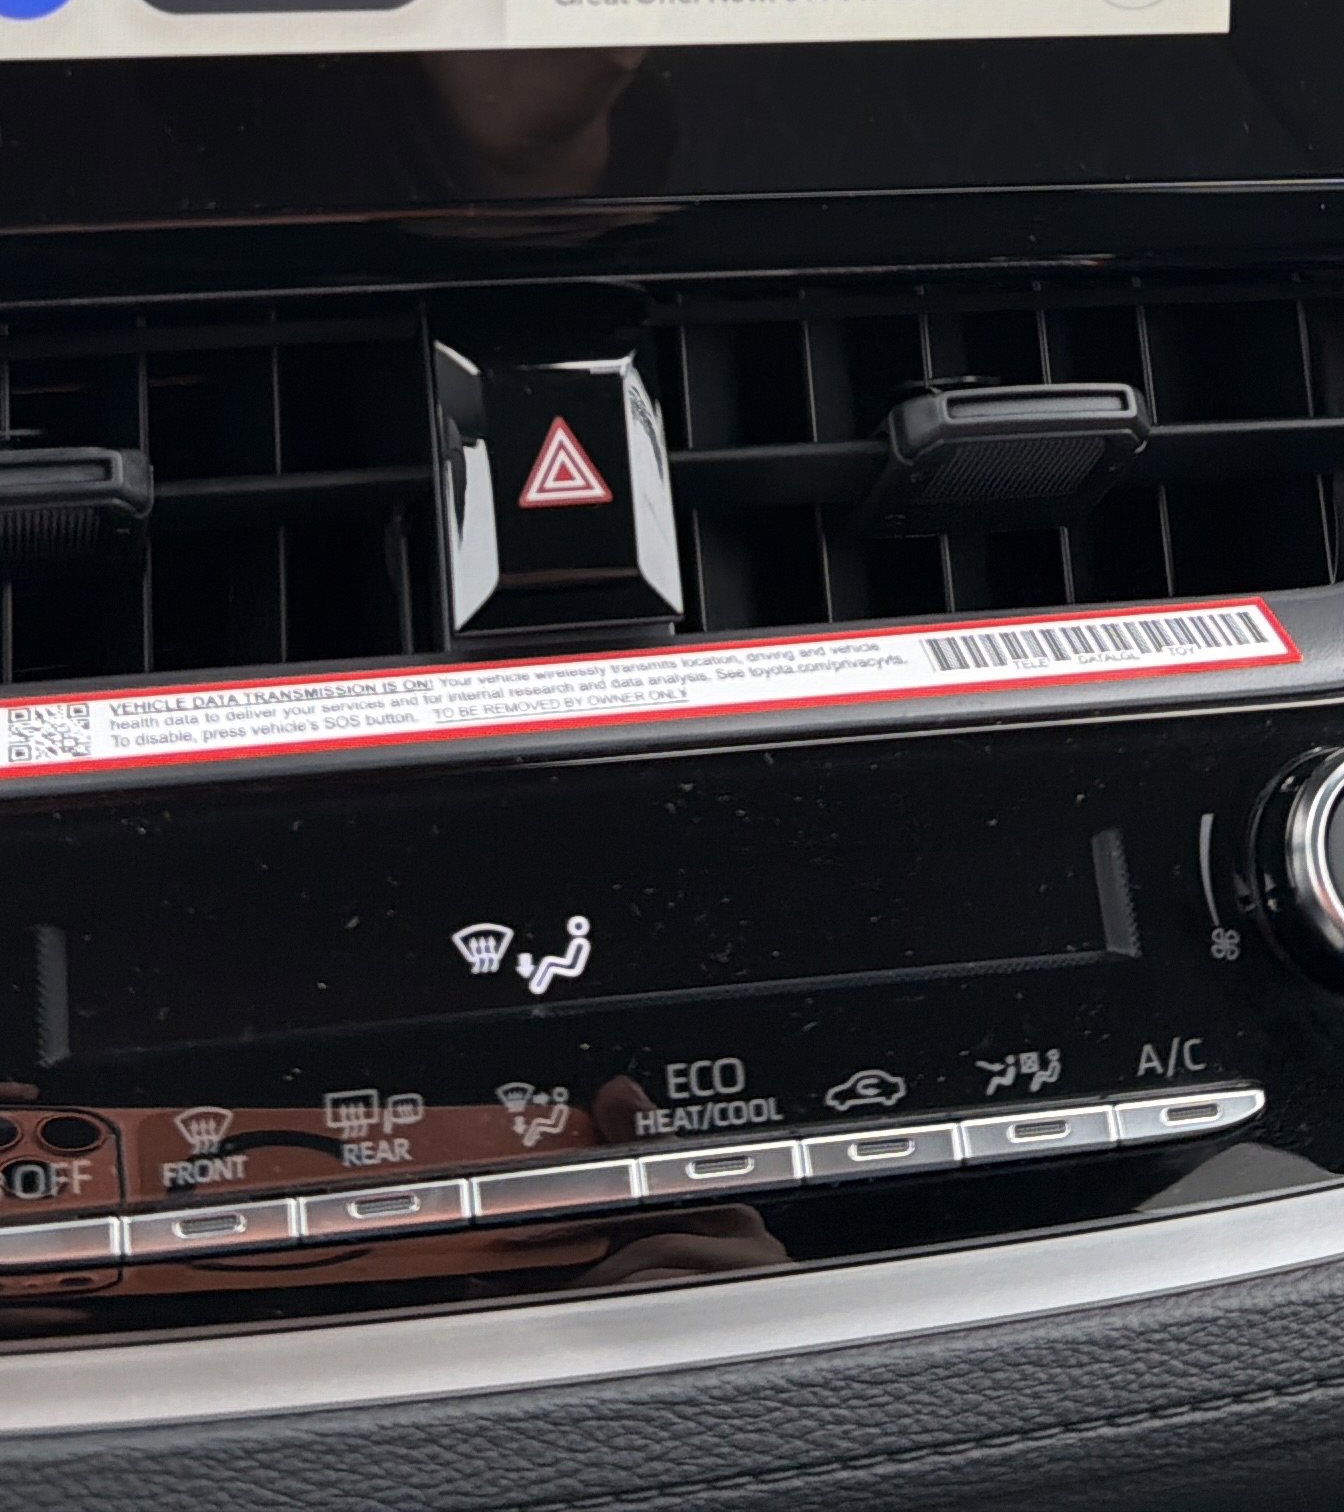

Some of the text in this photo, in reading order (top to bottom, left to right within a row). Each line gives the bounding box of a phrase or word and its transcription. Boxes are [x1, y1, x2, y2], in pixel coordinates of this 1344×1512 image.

[109, 697, 187, 716] VEHICLE
[192, 693, 239, 710] DATA
[243, 682, 377, 705] TRANSMISSION
[382, 680, 398, 693] IS
[439, 677, 473, 688] Your
[478, 673, 530, 685] vehicle
[611, 659, 678, 674] transmits
[799, 645, 826, 658] and
[830, 641, 880, 655] vehicle
[110, 717, 160, 731] health
[164, 713, 199, 727] data
[205, 711, 220, 724] to
[225, 705, 277, 722] deliver
[283, 704, 316, 719] your
[321, 699, 386, 714] services
[390, 694, 419, 708] and
[423, 692, 443, 705] for
[448, 687, 504, 703] internal
[509, 682, 576, 698] research
[579, 679, 607, 692] and
[610, 677, 644, 690] data
[715, 667, 746, 680] See
[111, 734, 131, 749] To
[203, 725, 247, 743] press
[251, 717, 320, 736] vehicle's
[324, 714, 361, 731] SOS
[432, 707, 455, 721] TO
[459, 705, 480, 719] BE
[483, 697, 561, 716] REMOVED
[564, 694, 583, 708] BY
[587, 690, 645, 706] OWNER
[649, 687, 689, 702] ONLY
[666, 1055, 746, 1100] ECO
[1136, 1035, 1209, 1077] A/C
[635, 1094, 785, 1137] HEAT/COOL
[162, 1154, 248, 1187] FRONT
[342, 1137, 413, 1168] REAR
[12, 1158, 94, 1199] OFF
